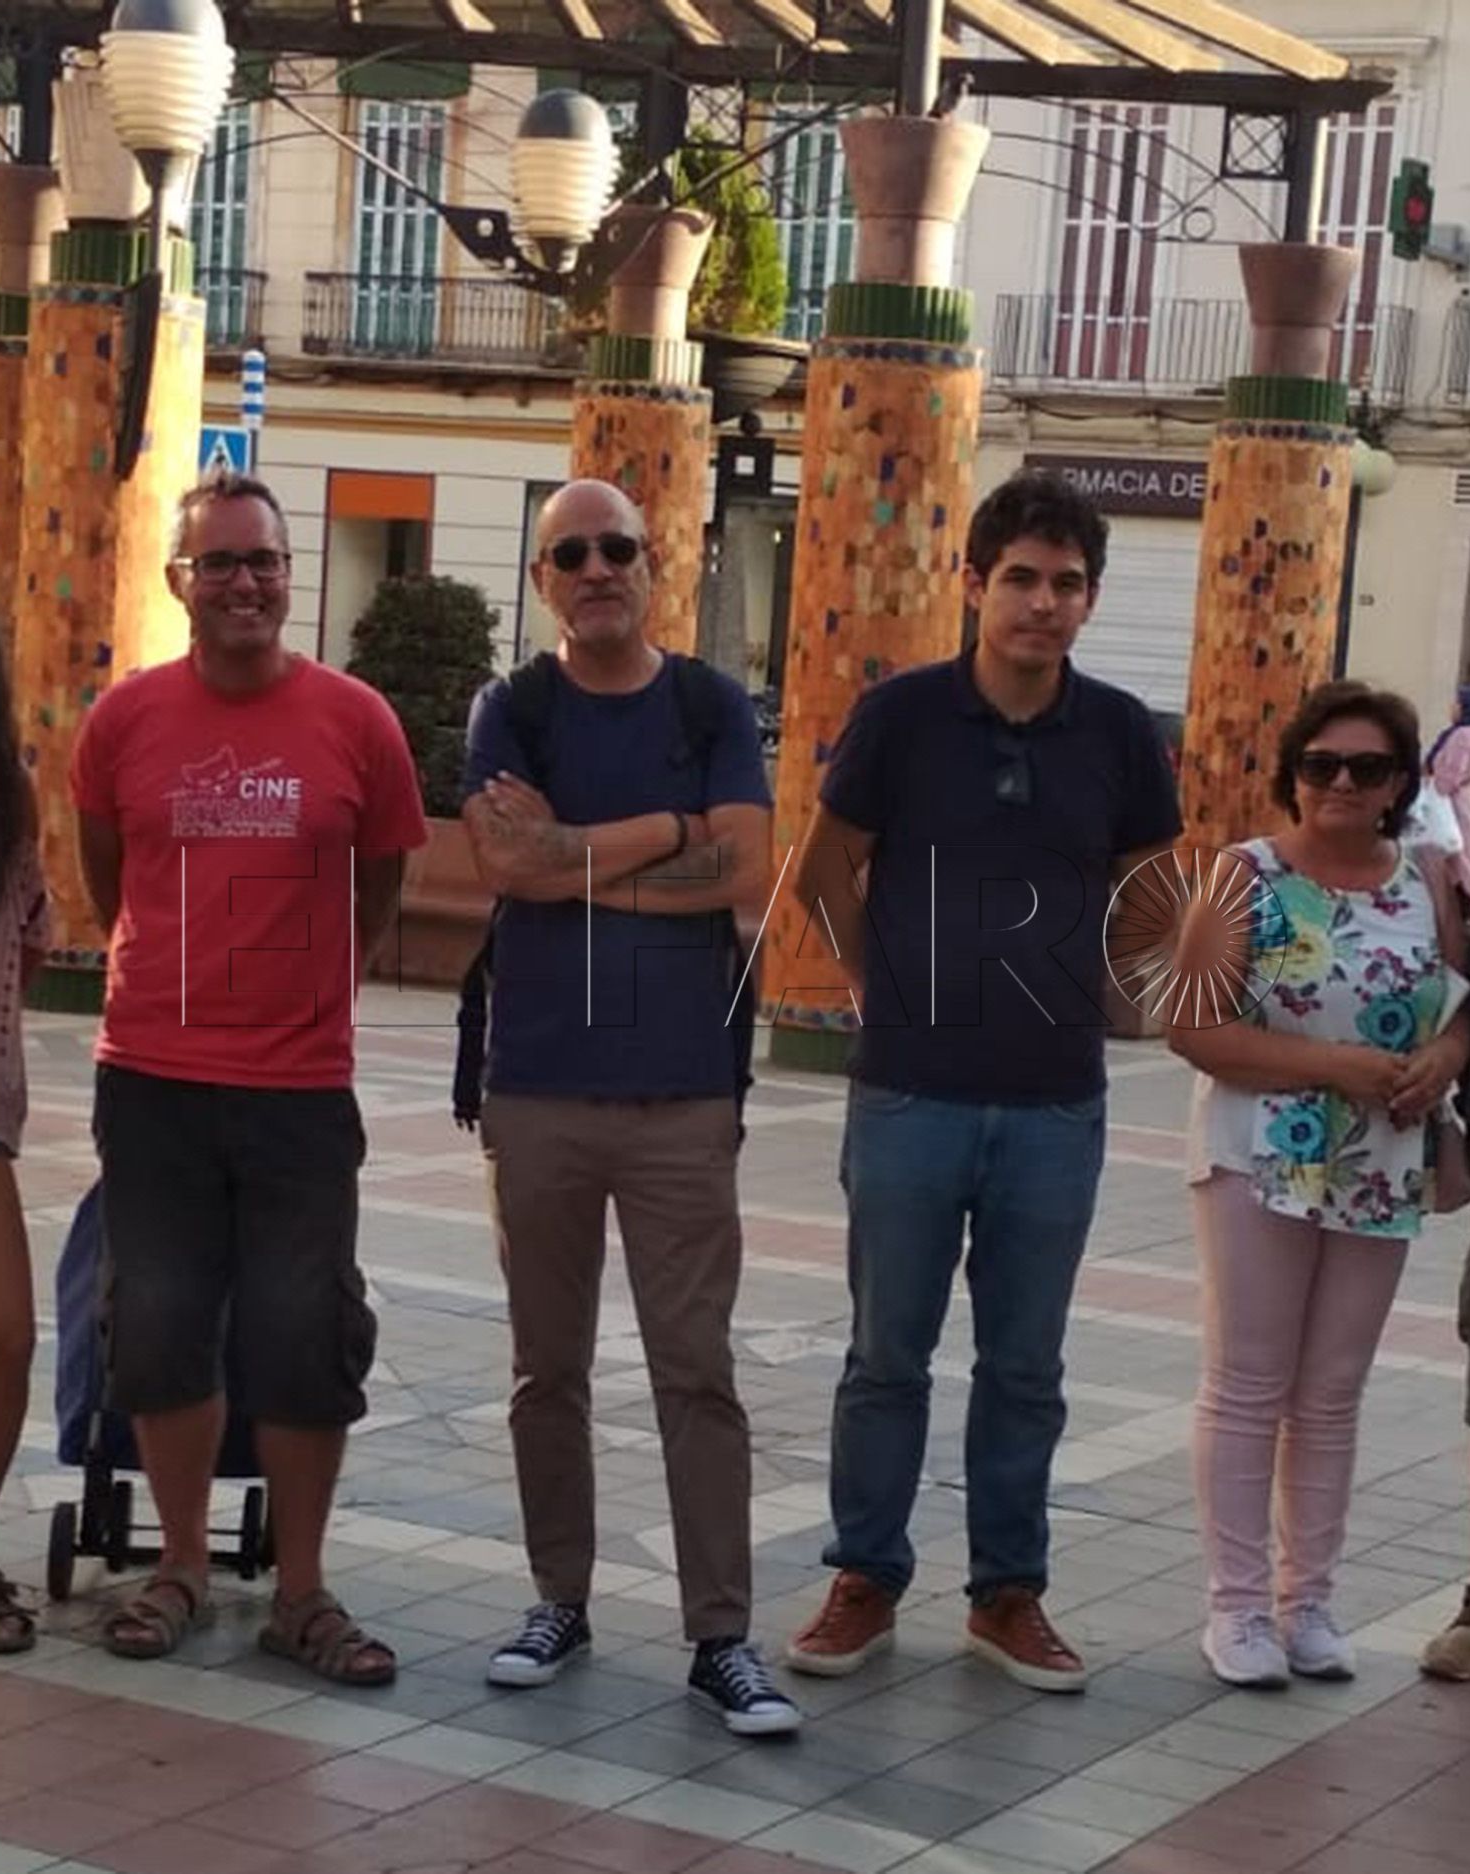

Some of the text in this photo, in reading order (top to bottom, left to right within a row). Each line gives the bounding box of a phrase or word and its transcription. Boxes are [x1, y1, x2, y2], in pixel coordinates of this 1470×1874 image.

[1033, 466, 1206, 499] RMACIA DE
[239, 777, 302, 800] CINE
